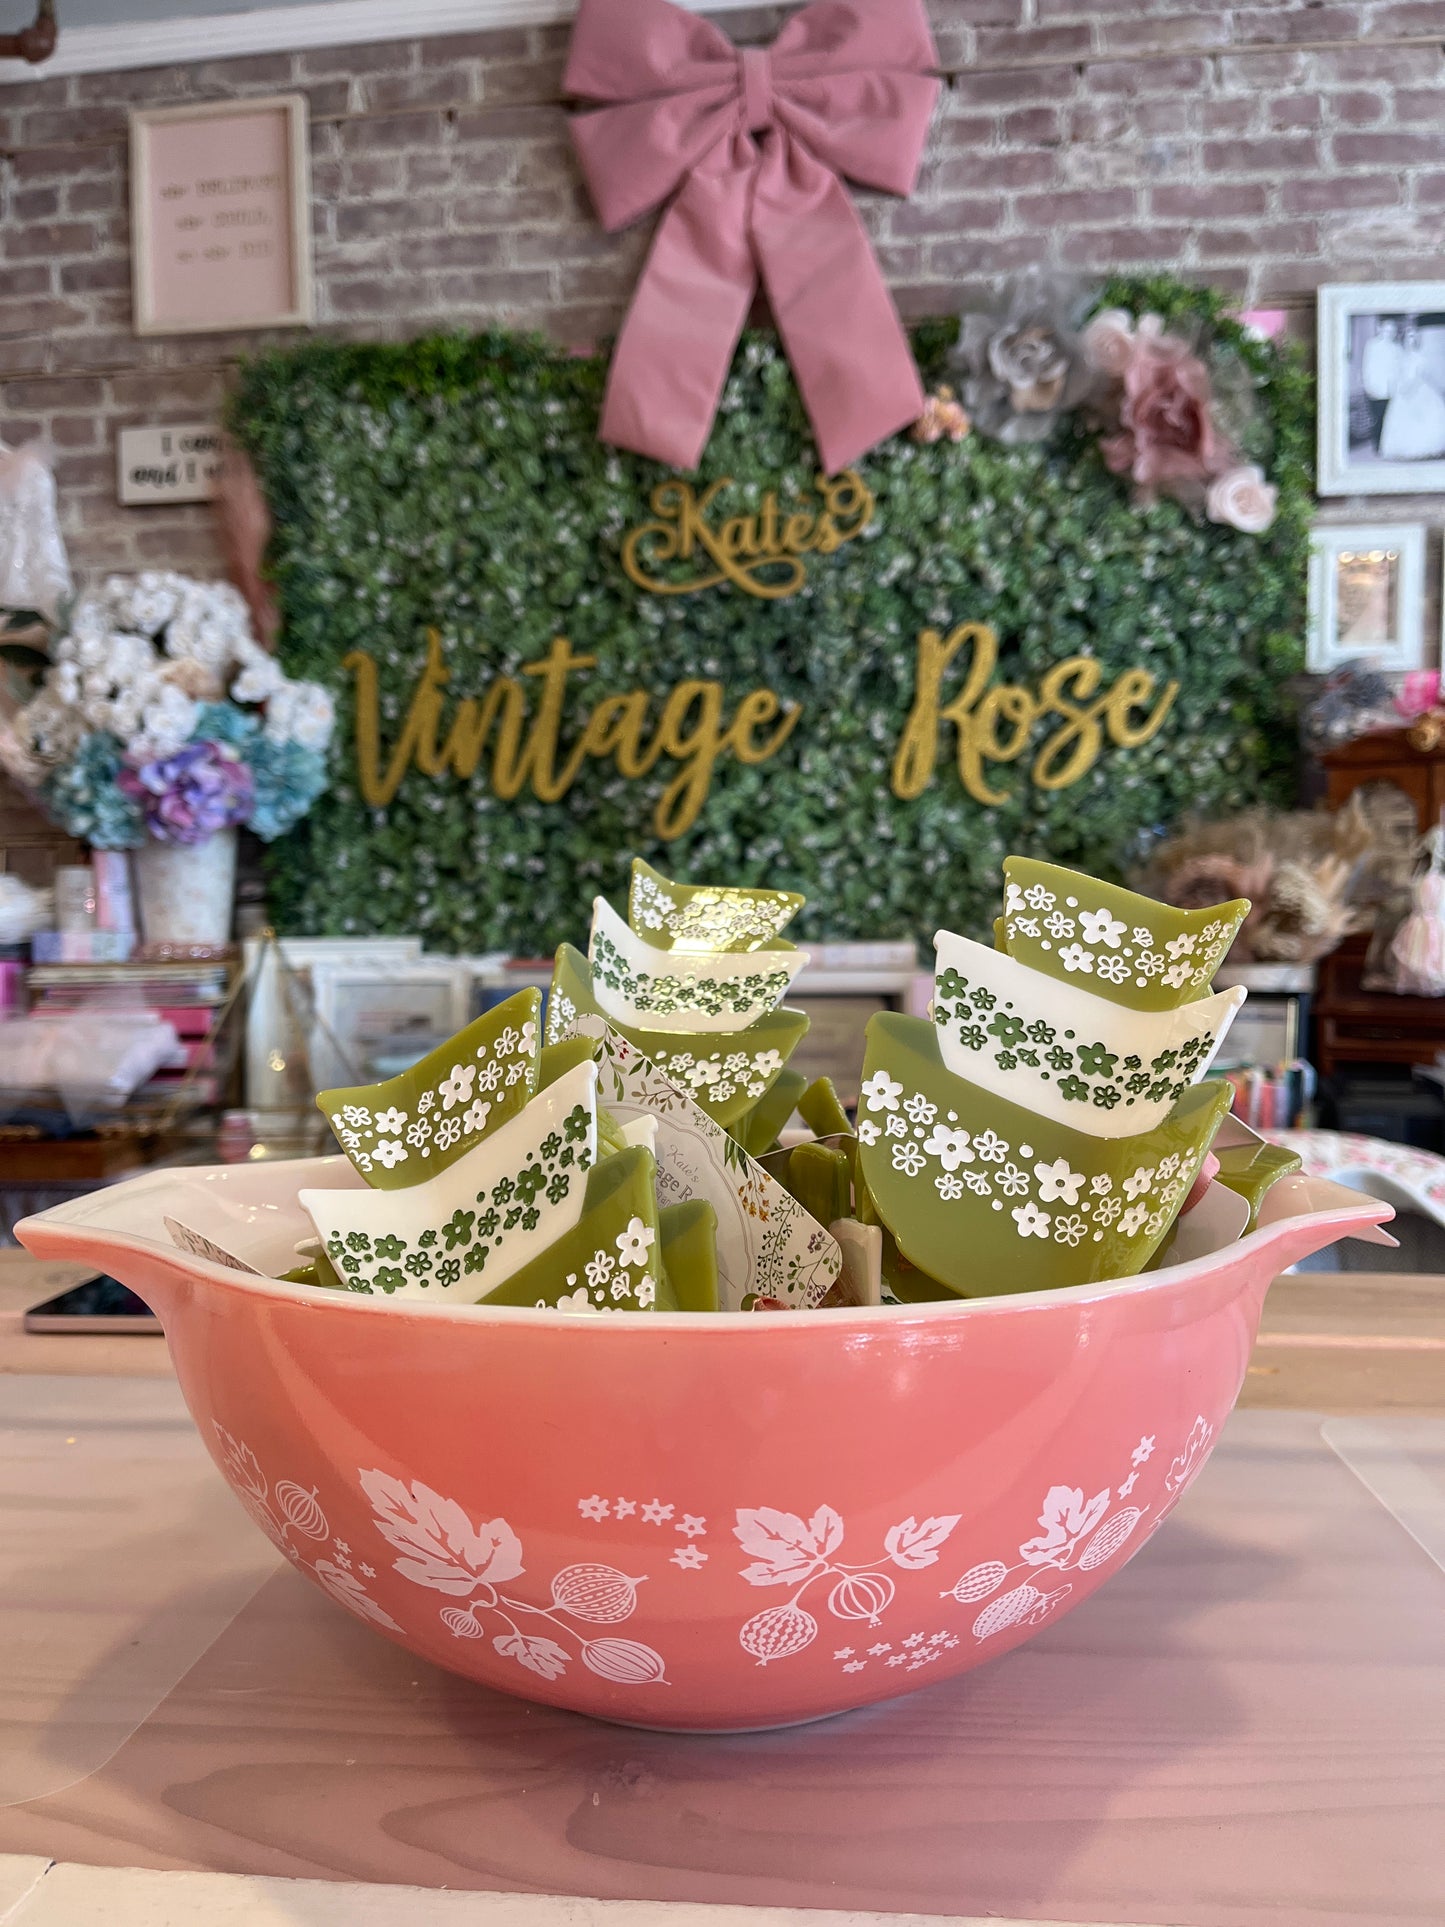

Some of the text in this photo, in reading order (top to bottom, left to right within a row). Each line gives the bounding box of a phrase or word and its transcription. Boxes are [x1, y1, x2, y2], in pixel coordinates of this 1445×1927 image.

[342, 621, 1179, 842] Vintage Rose
[666, 1144, 700, 1183] Kate's
